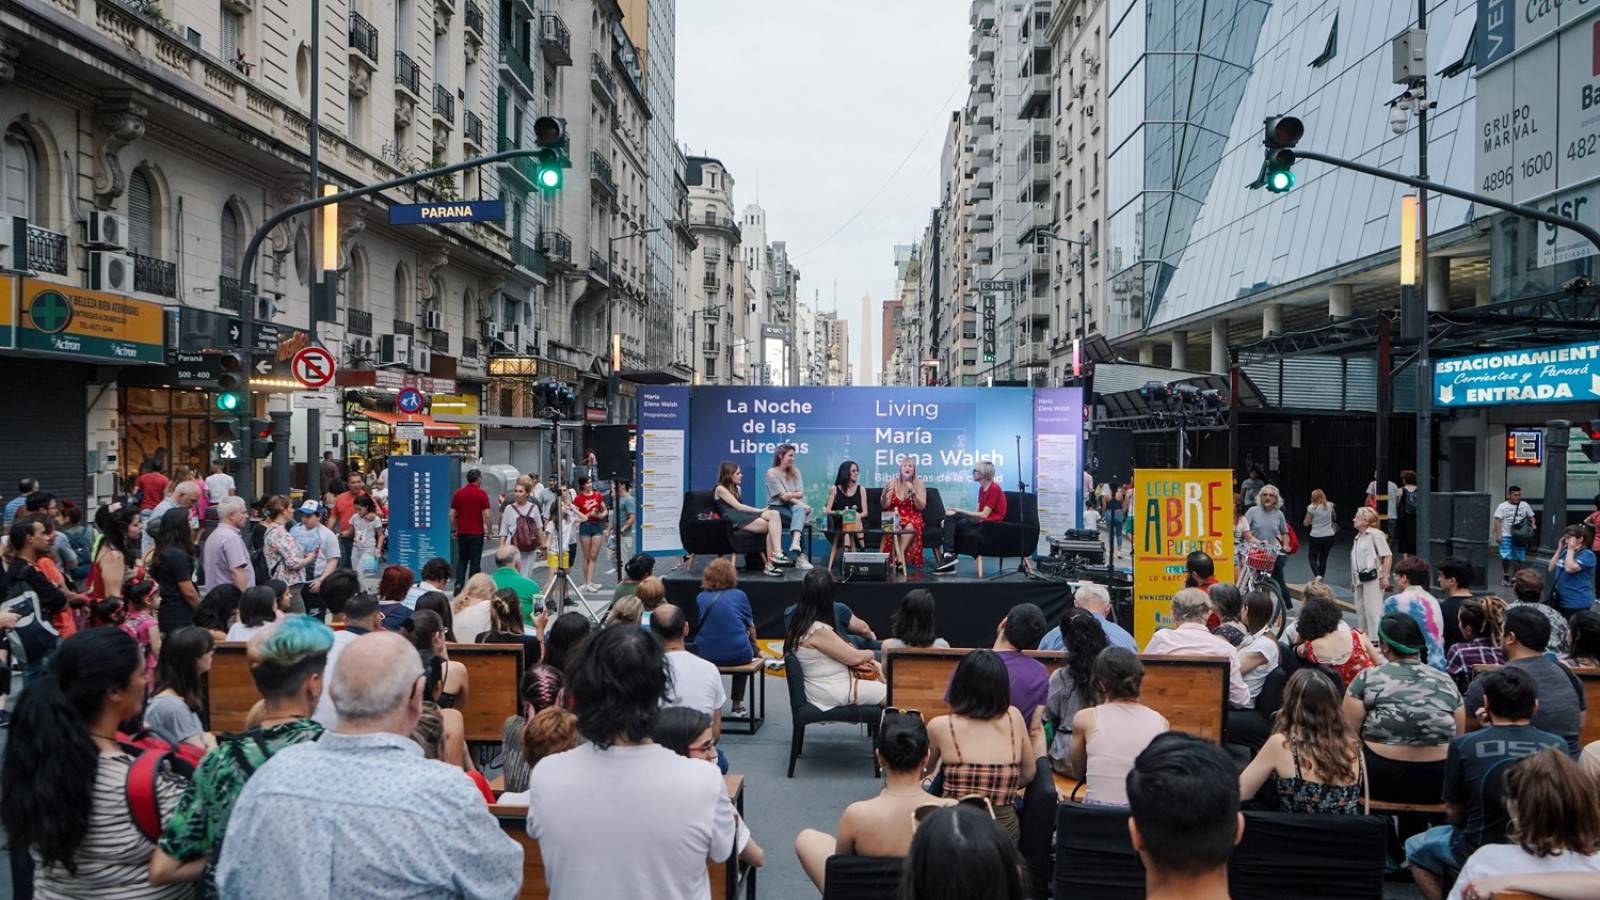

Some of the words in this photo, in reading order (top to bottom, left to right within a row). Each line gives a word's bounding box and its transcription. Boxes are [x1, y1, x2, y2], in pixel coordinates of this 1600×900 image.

[1483, 104, 1530, 138] GRUPO
[1484, 119, 1538, 154] MARVAL
[1566, 133, 1600, 161] 482
[1482, 166, 1514, 193] 4896
[1520, 150, 1553, 179] 1600
[421, 205, 473, 218] PARANA
[982, 282, 1012, 291] CINE
[54, 338, 81, 351] Actron
[114, 345, 137, 357] Actron
[178, 354, 203, 362] Paraná
[1436, 345, 1600, 374] ESTACIONAMIENT
[178, 371, 190, 379] 500
[196, 371, 210, 379] 400
[1454, 371, 1518, 385] Corrientes
[1519, 372, 1532, 384] y
[1539, 363, 1590, 378] Paraná
[1466, 383, 1574, 402] ENTRADA
[727, 399, 748, 413] La
[754, 399, 812, 414] Noche
[875, 400, 938, 420] Living
[742, 418, 765, 433] de
[771, 418, 796, 433] las
[875, 427, 932, 444] María
[730, 439, 809, 454] Libreas
[1514, 432, 1537, 460] E
[937, 472, 951, 483] de
[954, 472, 963, 483] la
[1146, 481, 1182, 497] LEER
[1144, 481, 1223, 555] ABRE
[1167, 539, 1222, 556] PUERTAS
